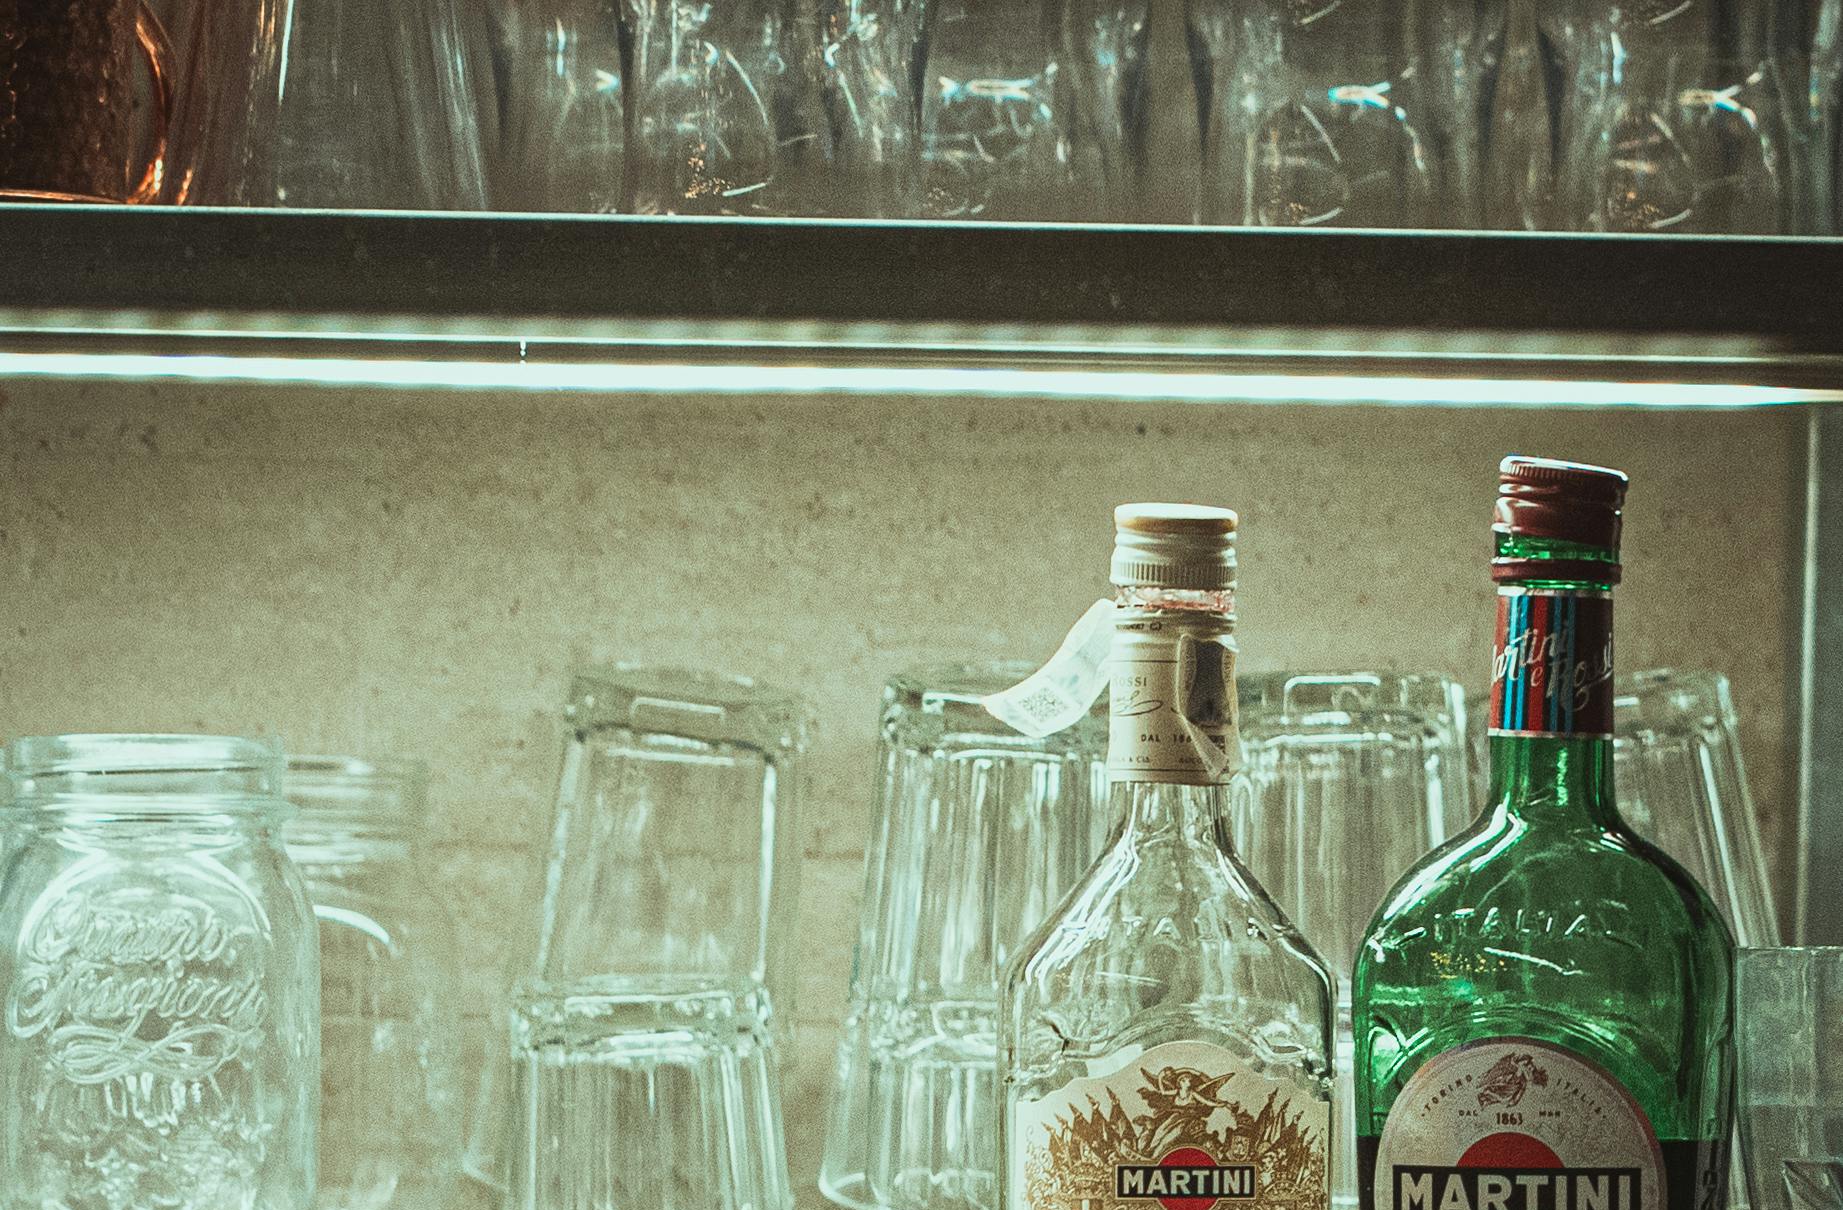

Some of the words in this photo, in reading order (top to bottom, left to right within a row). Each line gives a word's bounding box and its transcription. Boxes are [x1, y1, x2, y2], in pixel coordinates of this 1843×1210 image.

[1141, 734, 1161, 742] DAL
[1173, 734, 1193, 743] 186
[1496, 1112, 1524, 1126] 1863
[1123, 1169, 1252, 1196] MARTINI
